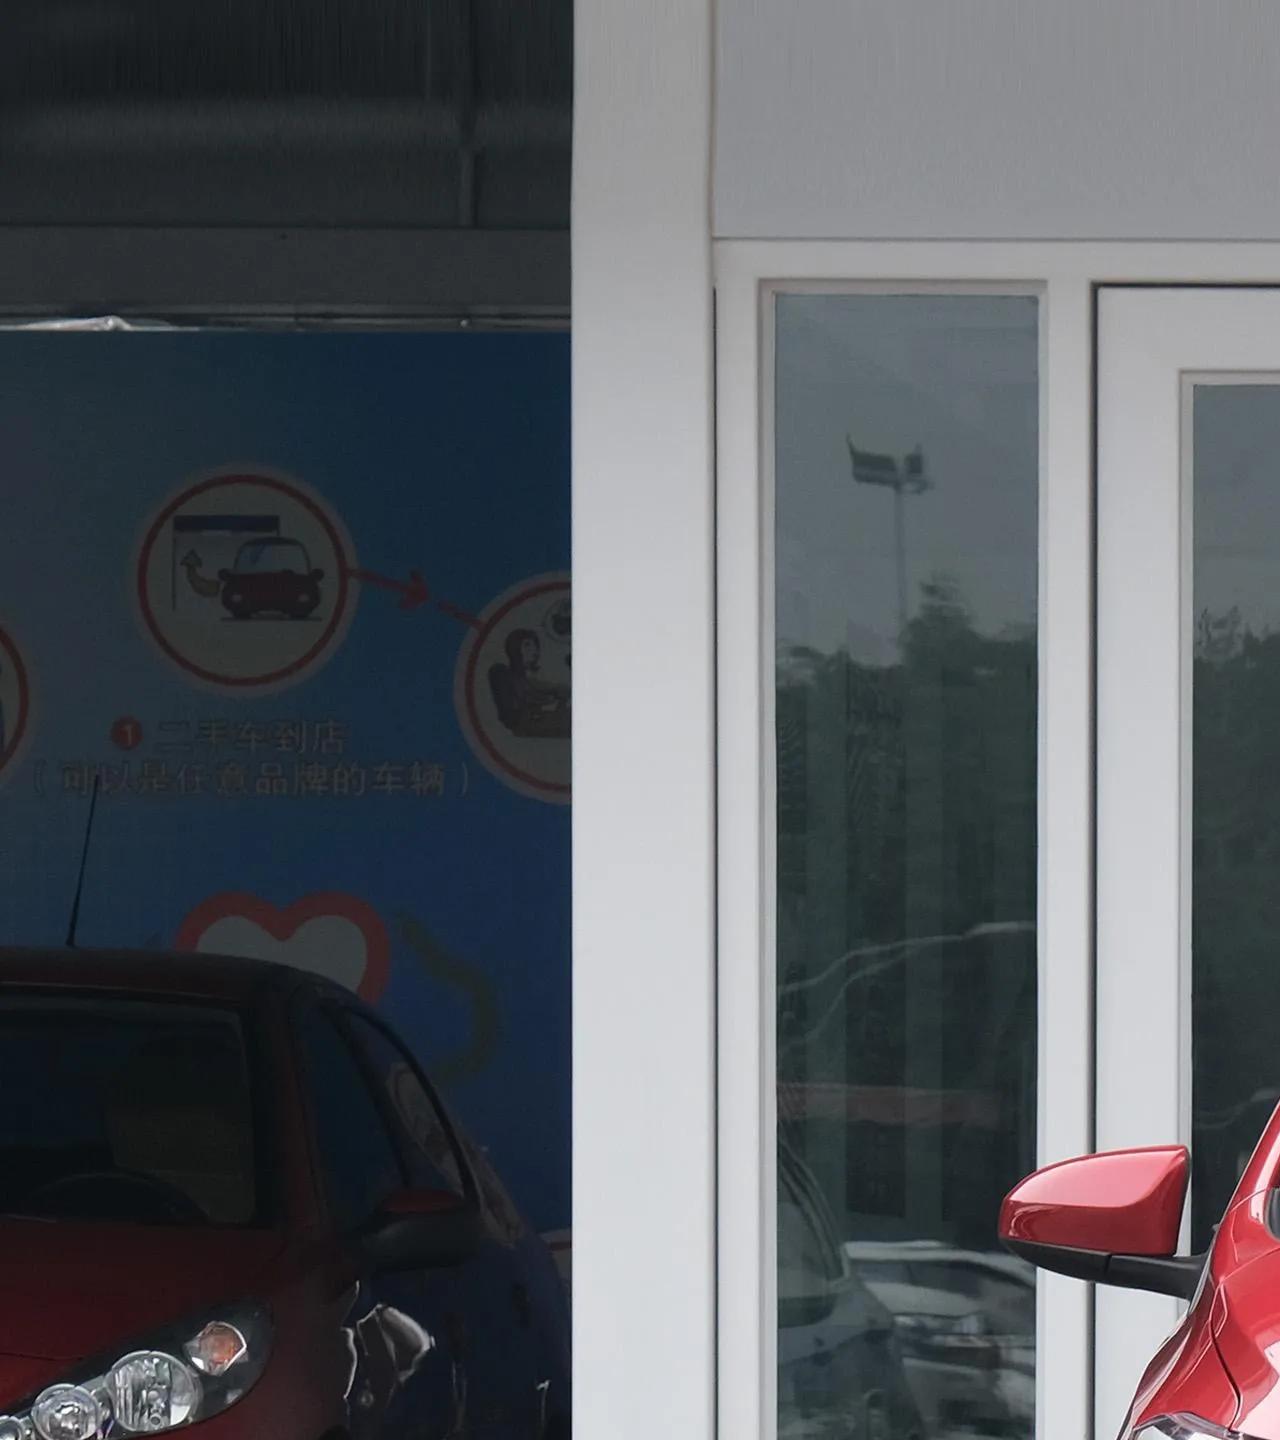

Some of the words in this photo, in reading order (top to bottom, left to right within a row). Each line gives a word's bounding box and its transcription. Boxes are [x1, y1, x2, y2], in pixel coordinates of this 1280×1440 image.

[157, 719, 349, 754] 二手车到店
